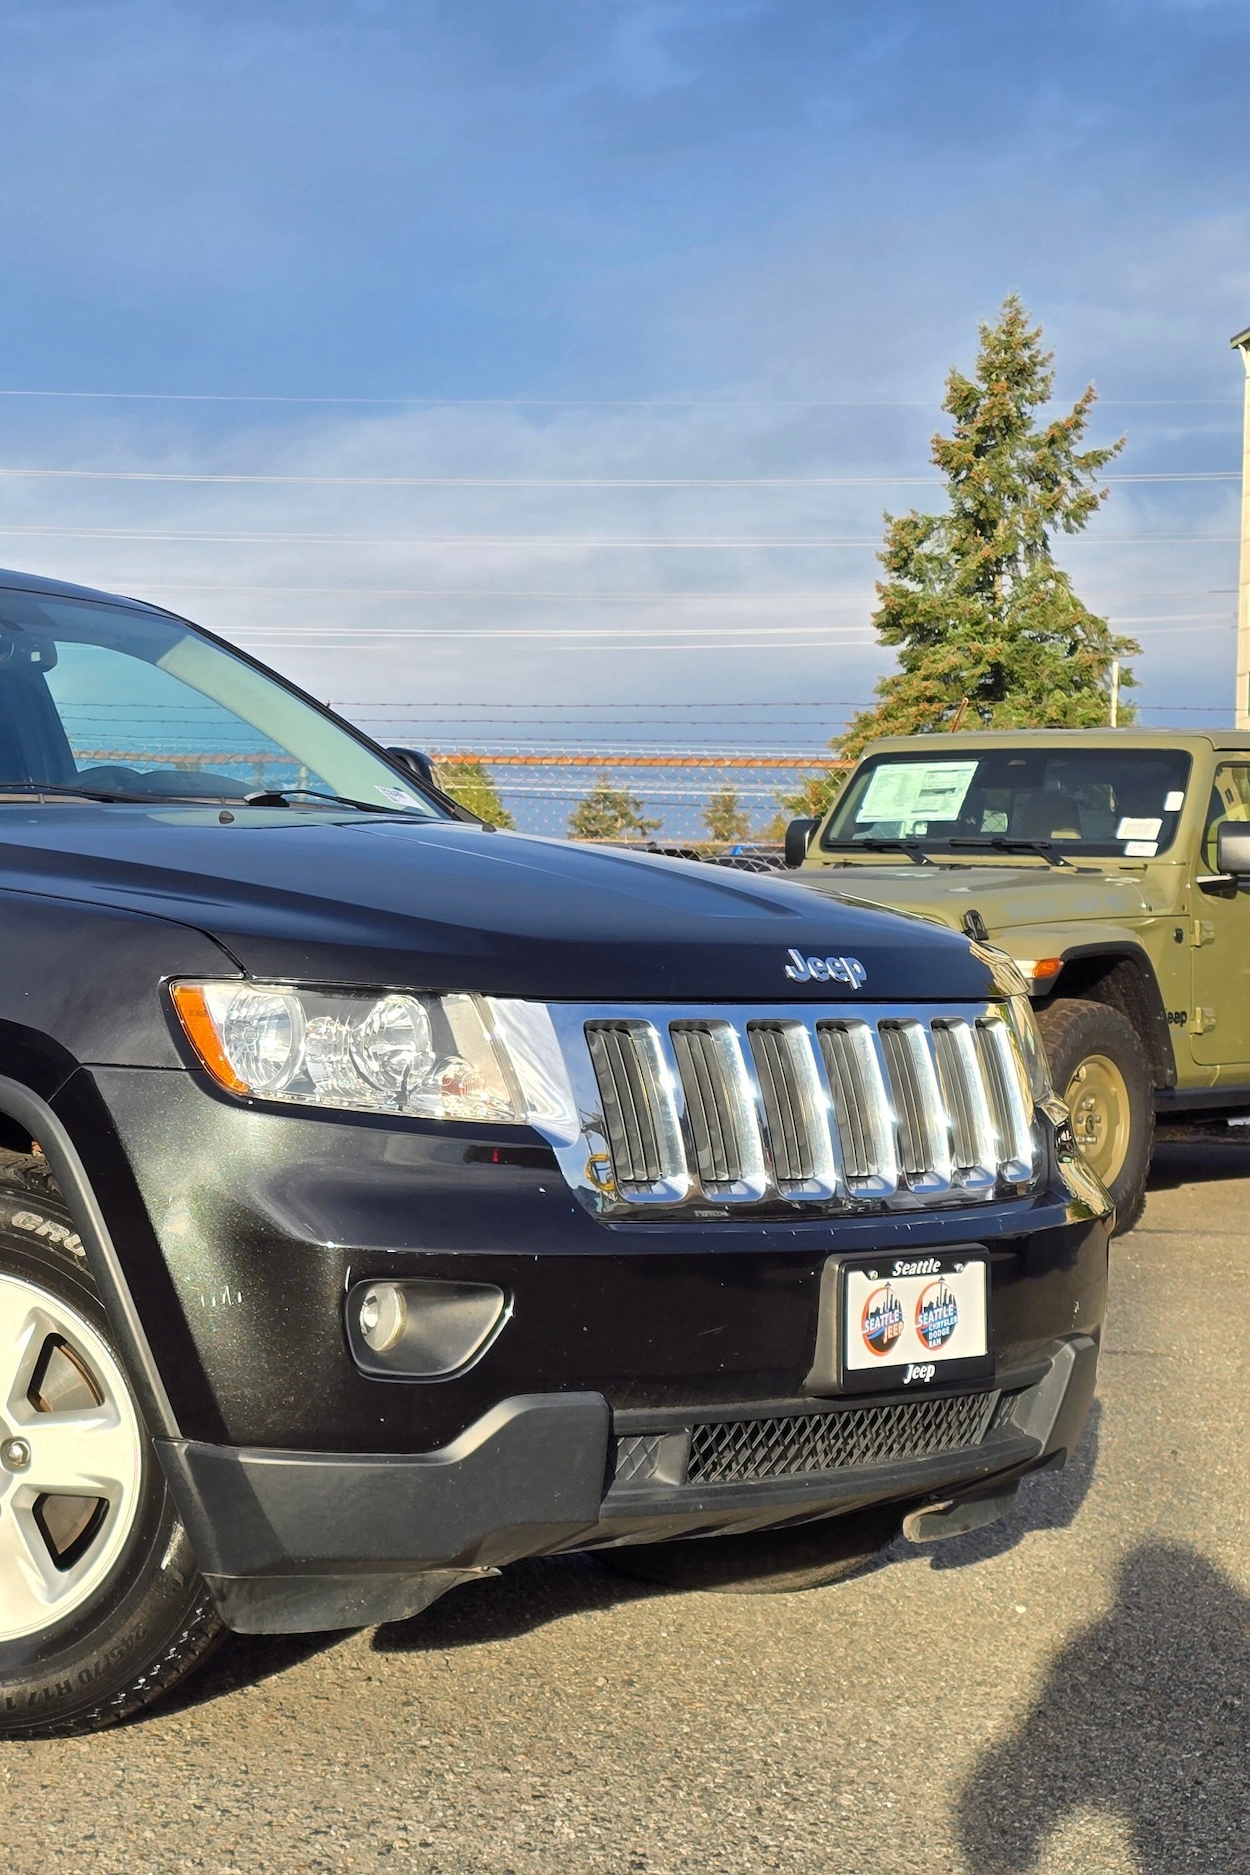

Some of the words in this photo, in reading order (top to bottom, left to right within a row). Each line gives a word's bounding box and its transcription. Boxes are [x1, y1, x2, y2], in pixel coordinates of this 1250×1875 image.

[784, 948, 867, 991] Jeep
[1166, 1008, 1187, 1028] eep
[892, 1258, 941, 1277] Seattle
[864, 1309, 900, 1331] SEATTLE
[918, 1304, 954, 1326] SEATTLE
[883, 1320, 904, 1344] JEEP
[928, 1326, 950, 1340] DODGE
[903, 1364, 936, 1384] Jeep
